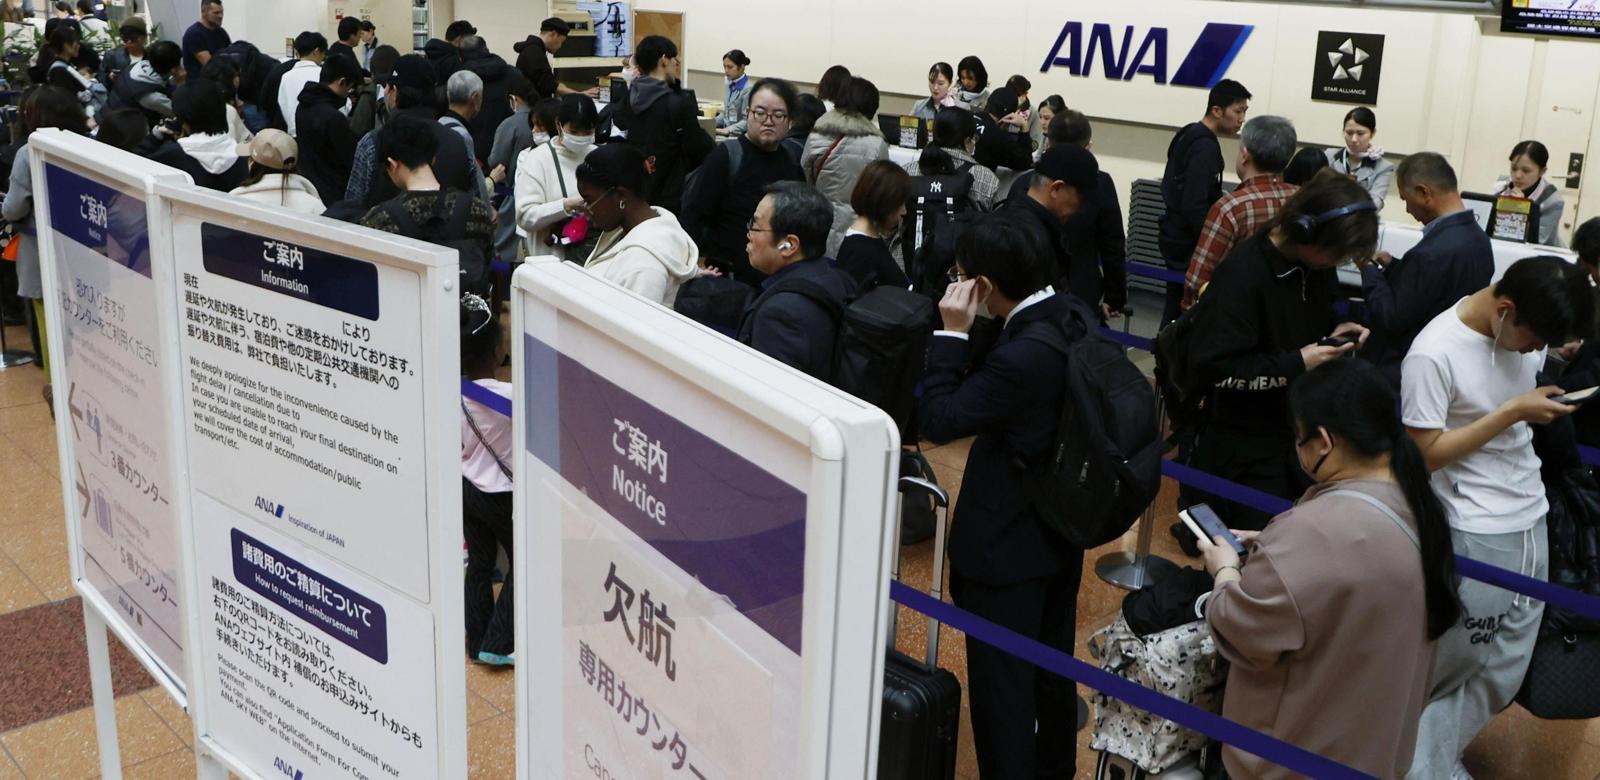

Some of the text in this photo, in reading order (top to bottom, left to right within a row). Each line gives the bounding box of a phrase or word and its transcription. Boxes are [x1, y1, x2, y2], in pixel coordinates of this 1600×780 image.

[1040, 21, 1168, 85] ANA
[80, 193, 108, 229] ご案内
[261, 269, 309, 295] Information
[263, 240, 304, 271] ご案内
[184, 272, 370, 342] 現在 により
[185, 290, 414, 376] 遅延や欠航が発生しており、ご迷惑をおかけしております。
[186, 307, 400, 390] 遅延や欠航に伴う、宿泊費や他の定期公共交通機関への
[187, 324, 336, 388] 振り替え費用は、弊社で負担いたします。
[189, 356, 399, 444] We deeply apologize for the inconvenience caused by the
[190, 369, 207, 384] flight
[209, 377, 226, 393] delay
[233, 387, 274, 410] cancellation
[276, 404, 290, 416] due
[292, 410, 300, 420] to
[1248, 376, 1287, 390] WEAR
[191, 382, 398, 474] In case you are unable to reach your final destination on
[193, 398, 295, 448] your scheduled date of arrival,
[194, 411, 203, 421] we
[204, 416, 216, 426] will
[217, 421, 235, 434] cover
[236, 428, 248, 440] the
[249, 434, 264, 447] cost
[266, 441, 273, 451] of
[612, 417, 667, 483] ご案内
[255, 496, 345, 548] ANA Inspiration of JAPAN
[613, 464, 666, 526] Notice
[242, 540, 371, 628] 諸費用のご精算について
[255, 573, 358, 639] How to request reimbursement
[212, 576, 335, 661] 諸費用のご精算方法については、
[214, 594, 372, 701] 右下のQRコードをお読み取りください。
[603, 561, 676, 682] 欠航
[215, 612, 422, 749] ANAウェブサイト内 補償のお申込みサイトからも
[216, 628, 293, 688] 手続きいただけます。
[218, 653, 399, 777] Please scan the QR code and proceed to submit your
[220, 690, 234, 704] ANA
[236, 699, 248, 713] SKY
[269, 724, 277, 735] on
[279, 729, 290, 744] the
[221, 679, 232, 691] You
[233, 688, 244, 699] can
[245, 697, 258, 710] also
[260, 704, 272, 719] find
[316, 743, 336, 763] Form
[338, 757, 350, 772] For
[578, 639, 708, 780] 専用カウンター
[274, 756, 293, 778] ANA
[584, 744, 616, 780] Can
